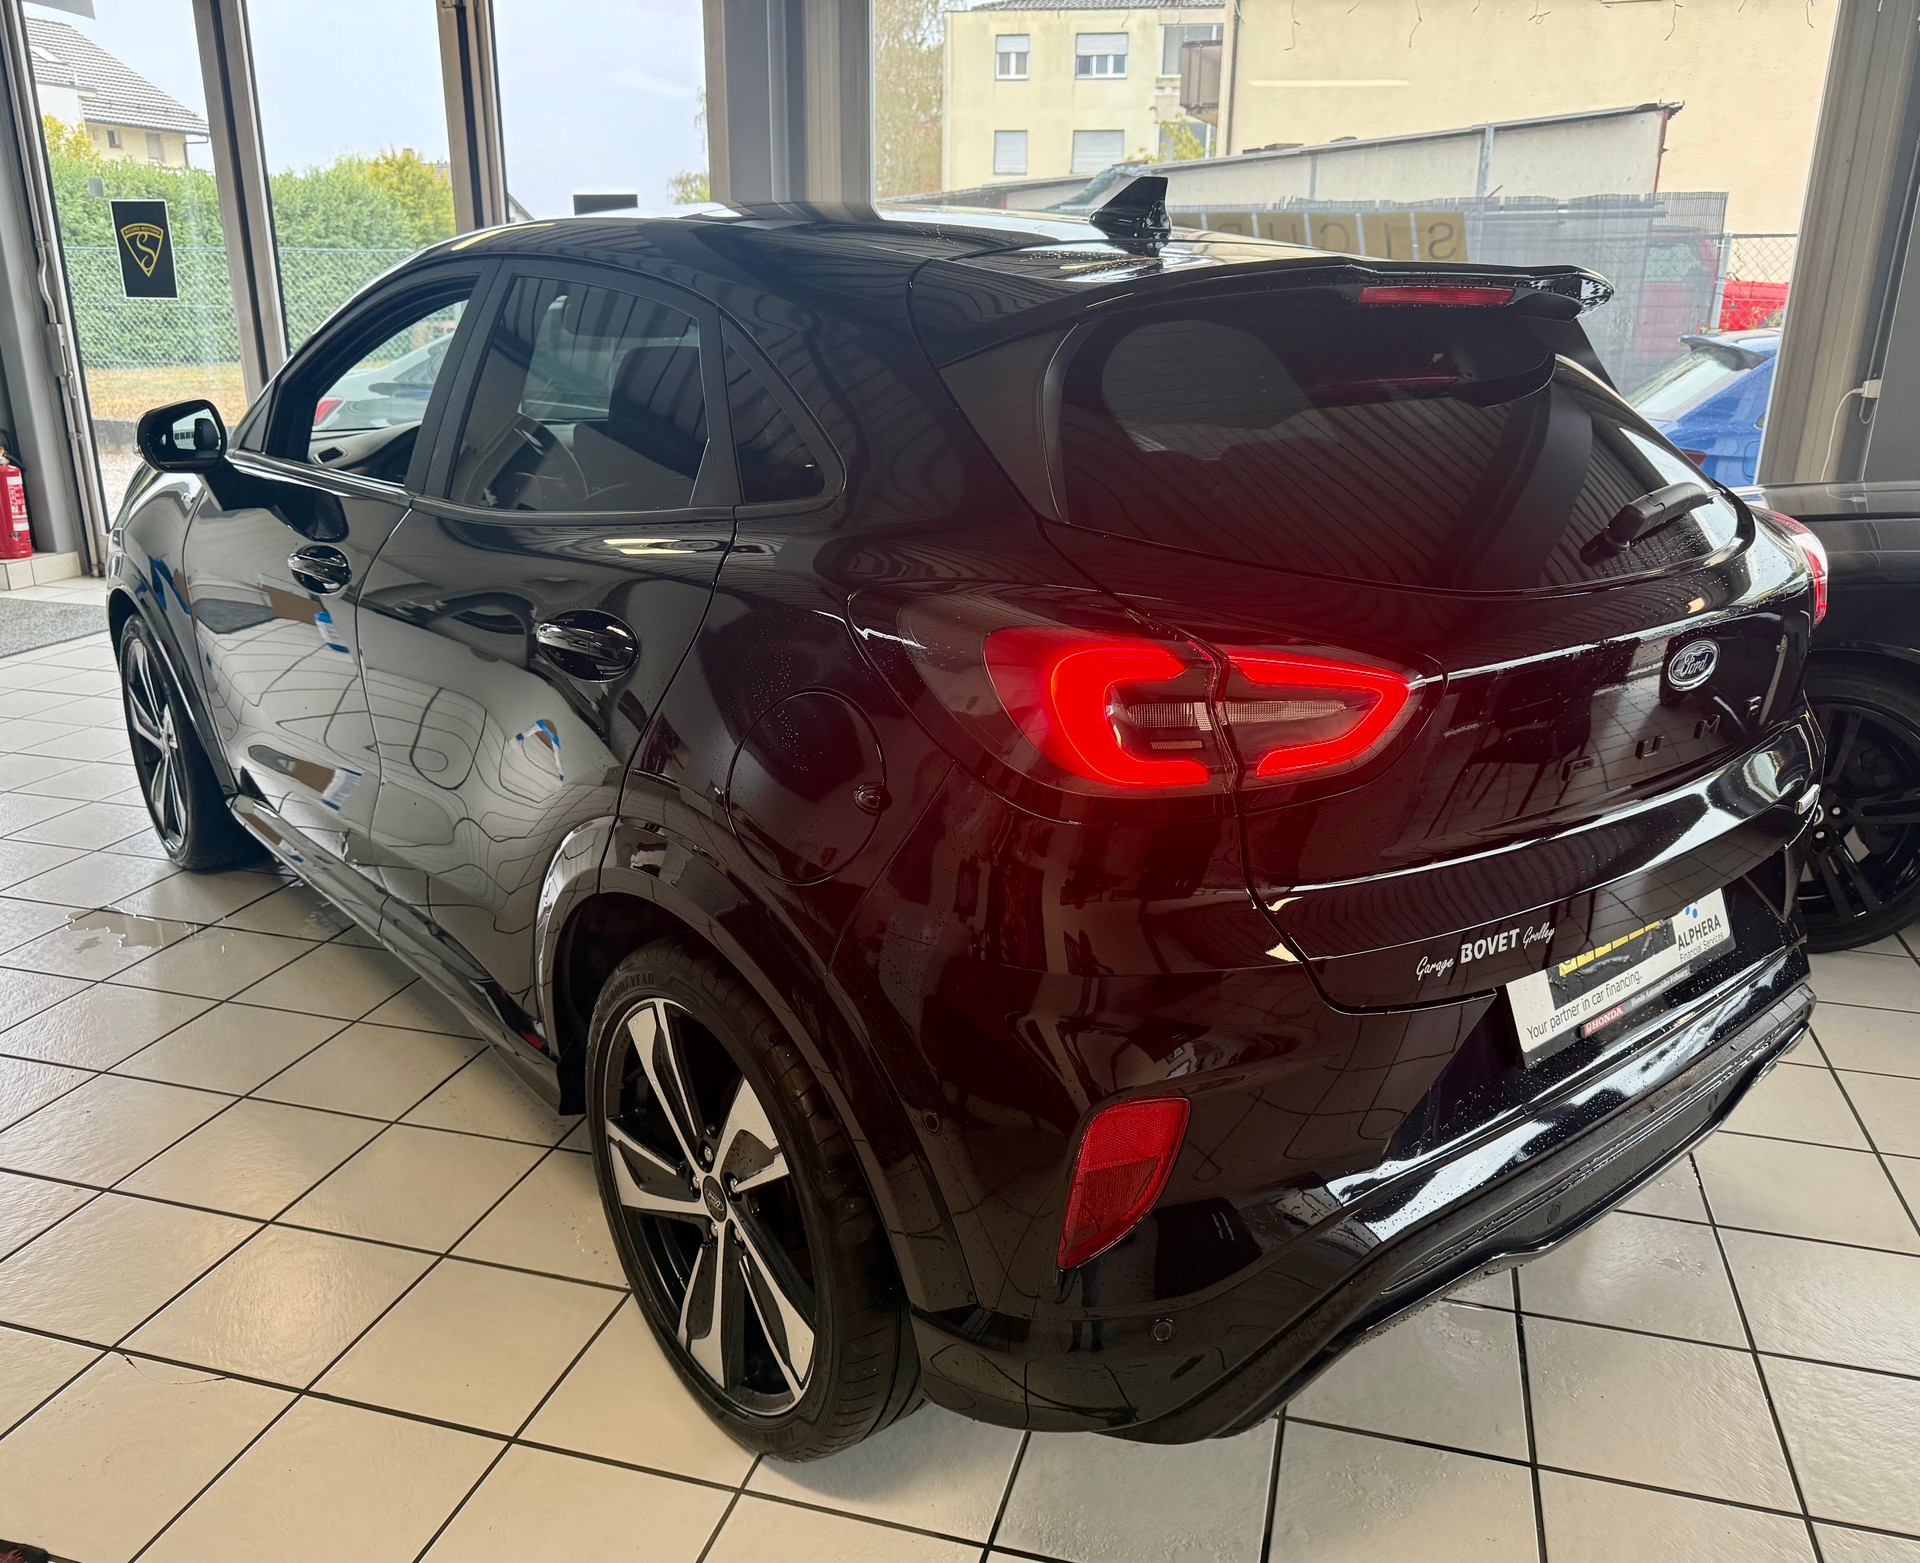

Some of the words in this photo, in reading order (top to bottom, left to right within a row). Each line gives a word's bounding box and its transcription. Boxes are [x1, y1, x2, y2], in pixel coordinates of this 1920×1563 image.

[1679, 652, 1709, 677] Ford
[1561, 695, 1763, 782] PUMA
[1416, 956, 1454, 981] Garage
[1460, 928, 1520, 964] BOVET
[1523, 921, 1556, 950] Grolley
[1678, 914, 1721, 951] ALPHERA
[1680, 943, 1703, 963] Financial
[1703, 932, 1724, 952] Services
[1526, 1021, 1547, 1040] Your
[1550, 1004, 1580, 1032] partner
[1581, 997, 1591, 1011] in
[1592, 990, 1604, 1007] car
[1605, 970, 1643, 998] financing.
[1592, 1006, 1624, 1029] HONDA
